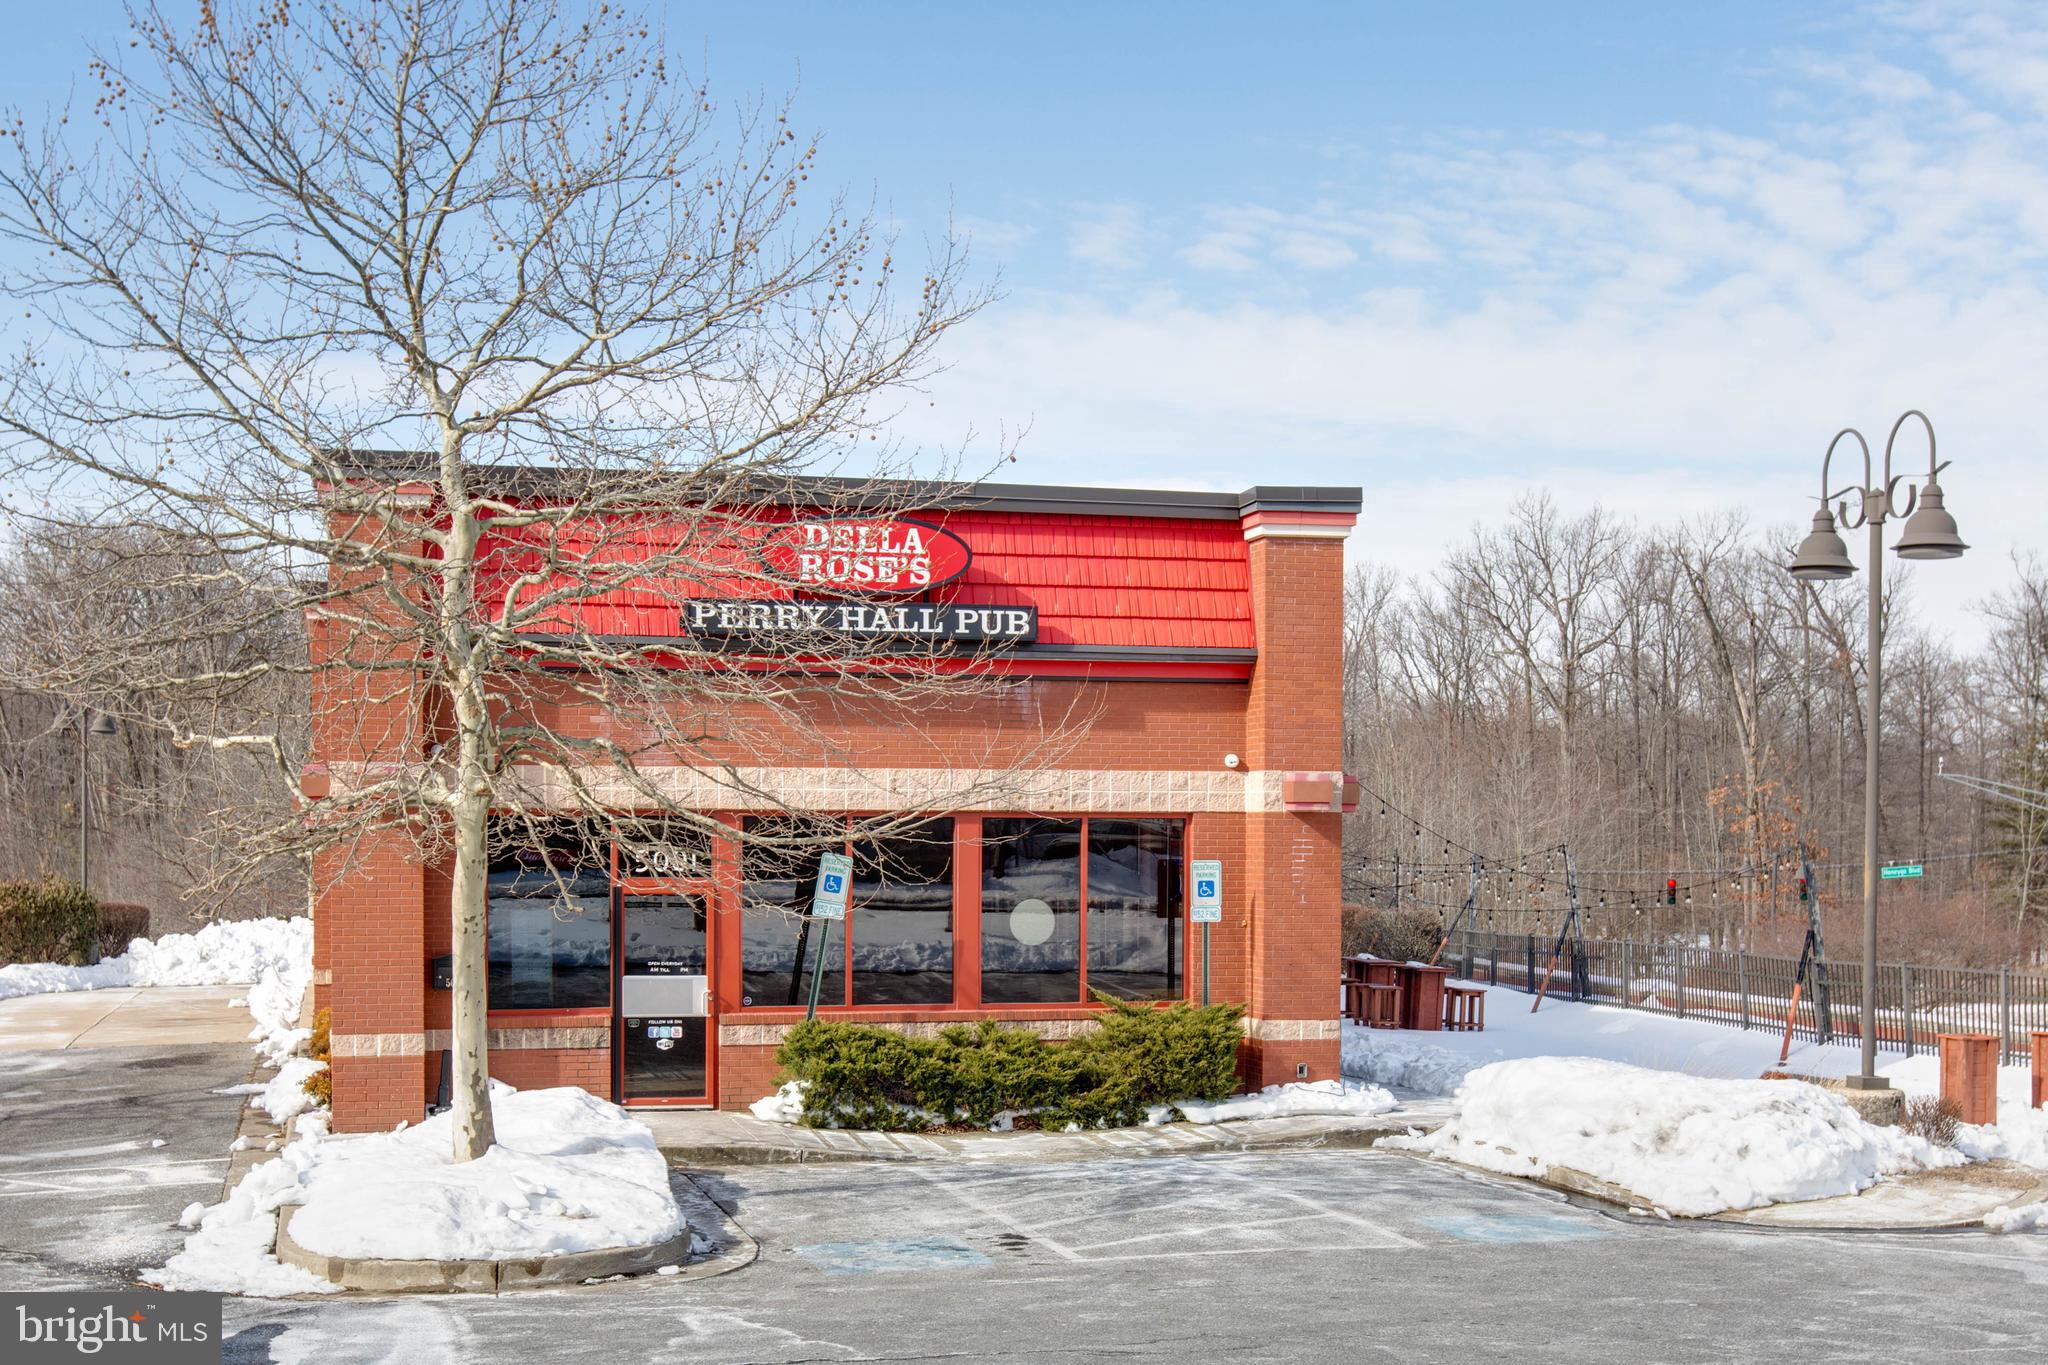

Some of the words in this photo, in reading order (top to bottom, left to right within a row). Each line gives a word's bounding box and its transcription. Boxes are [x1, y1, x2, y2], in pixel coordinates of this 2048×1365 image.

[804, 523, 922, 553] DELLA
[800, 553, 931, 584] ROSE'S
[692, 603, 829, 630] PERRY
[838, 606, 944, 633] HALL
[955, 608, 1031, 635] PUB
